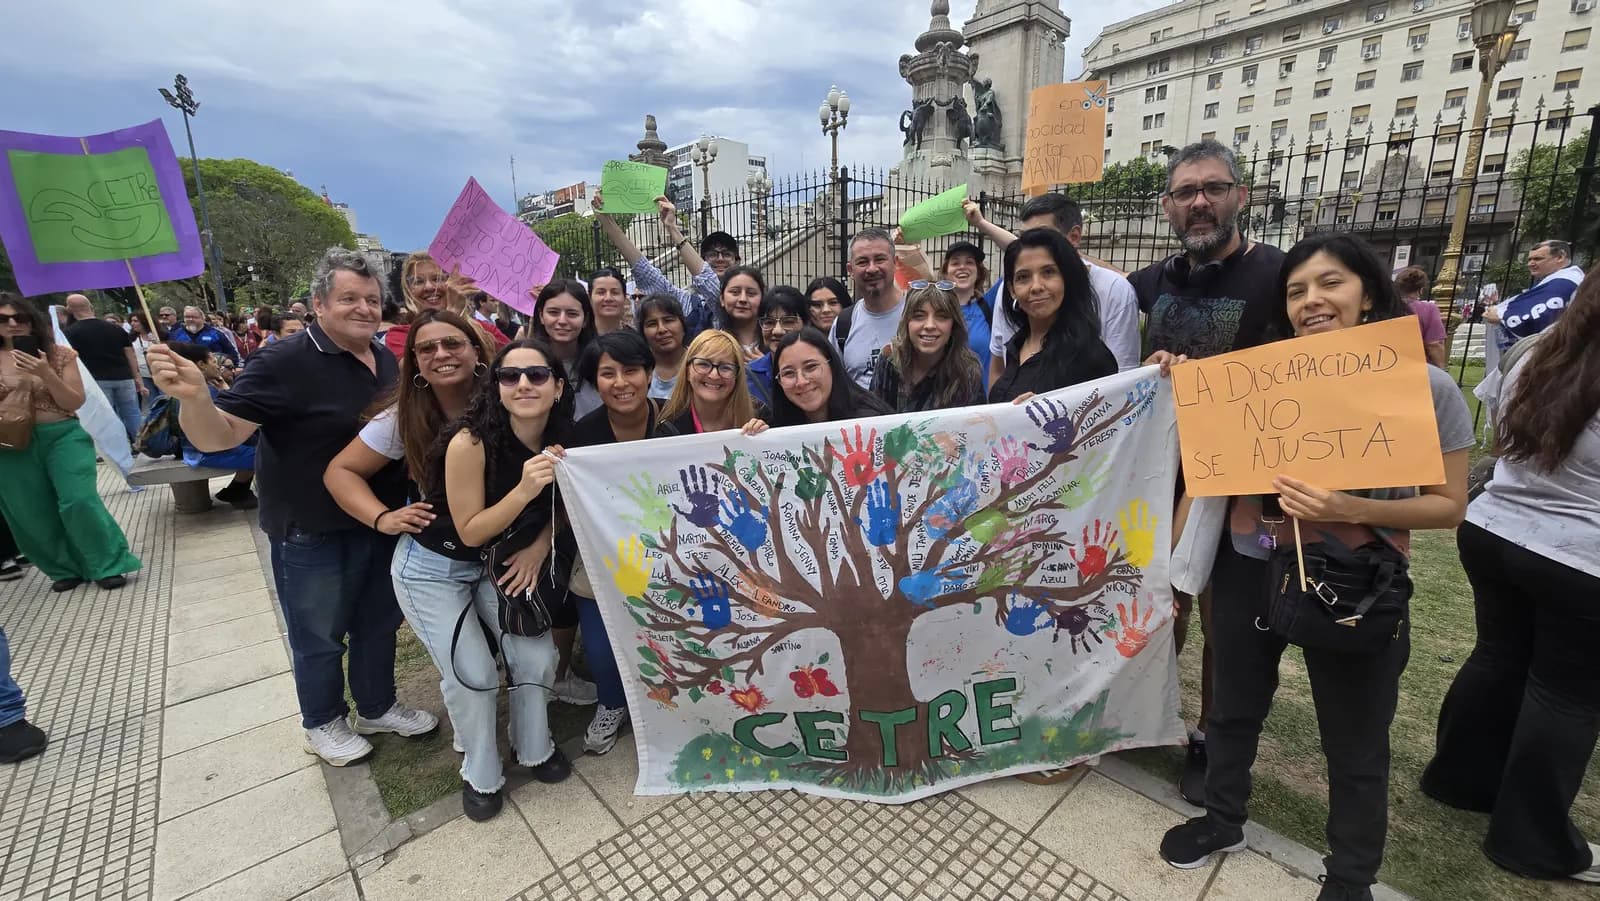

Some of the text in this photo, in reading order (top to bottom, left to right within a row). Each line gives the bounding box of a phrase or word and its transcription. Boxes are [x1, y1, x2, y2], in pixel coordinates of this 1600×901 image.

[1172, 366, 1214, 407] LA
[1243, 398, 1300, 432] NO
[1082, 428, 1118, 450] TERESA
[1193, 421, 1395, 479] SE AJUSTA
[645, 549, 663, 559] LEO
[755, 587, 797, 613] LEANDRO
[735, 609, 760, 622] JOSE
[732, 677, 1021, 768] CETRE
